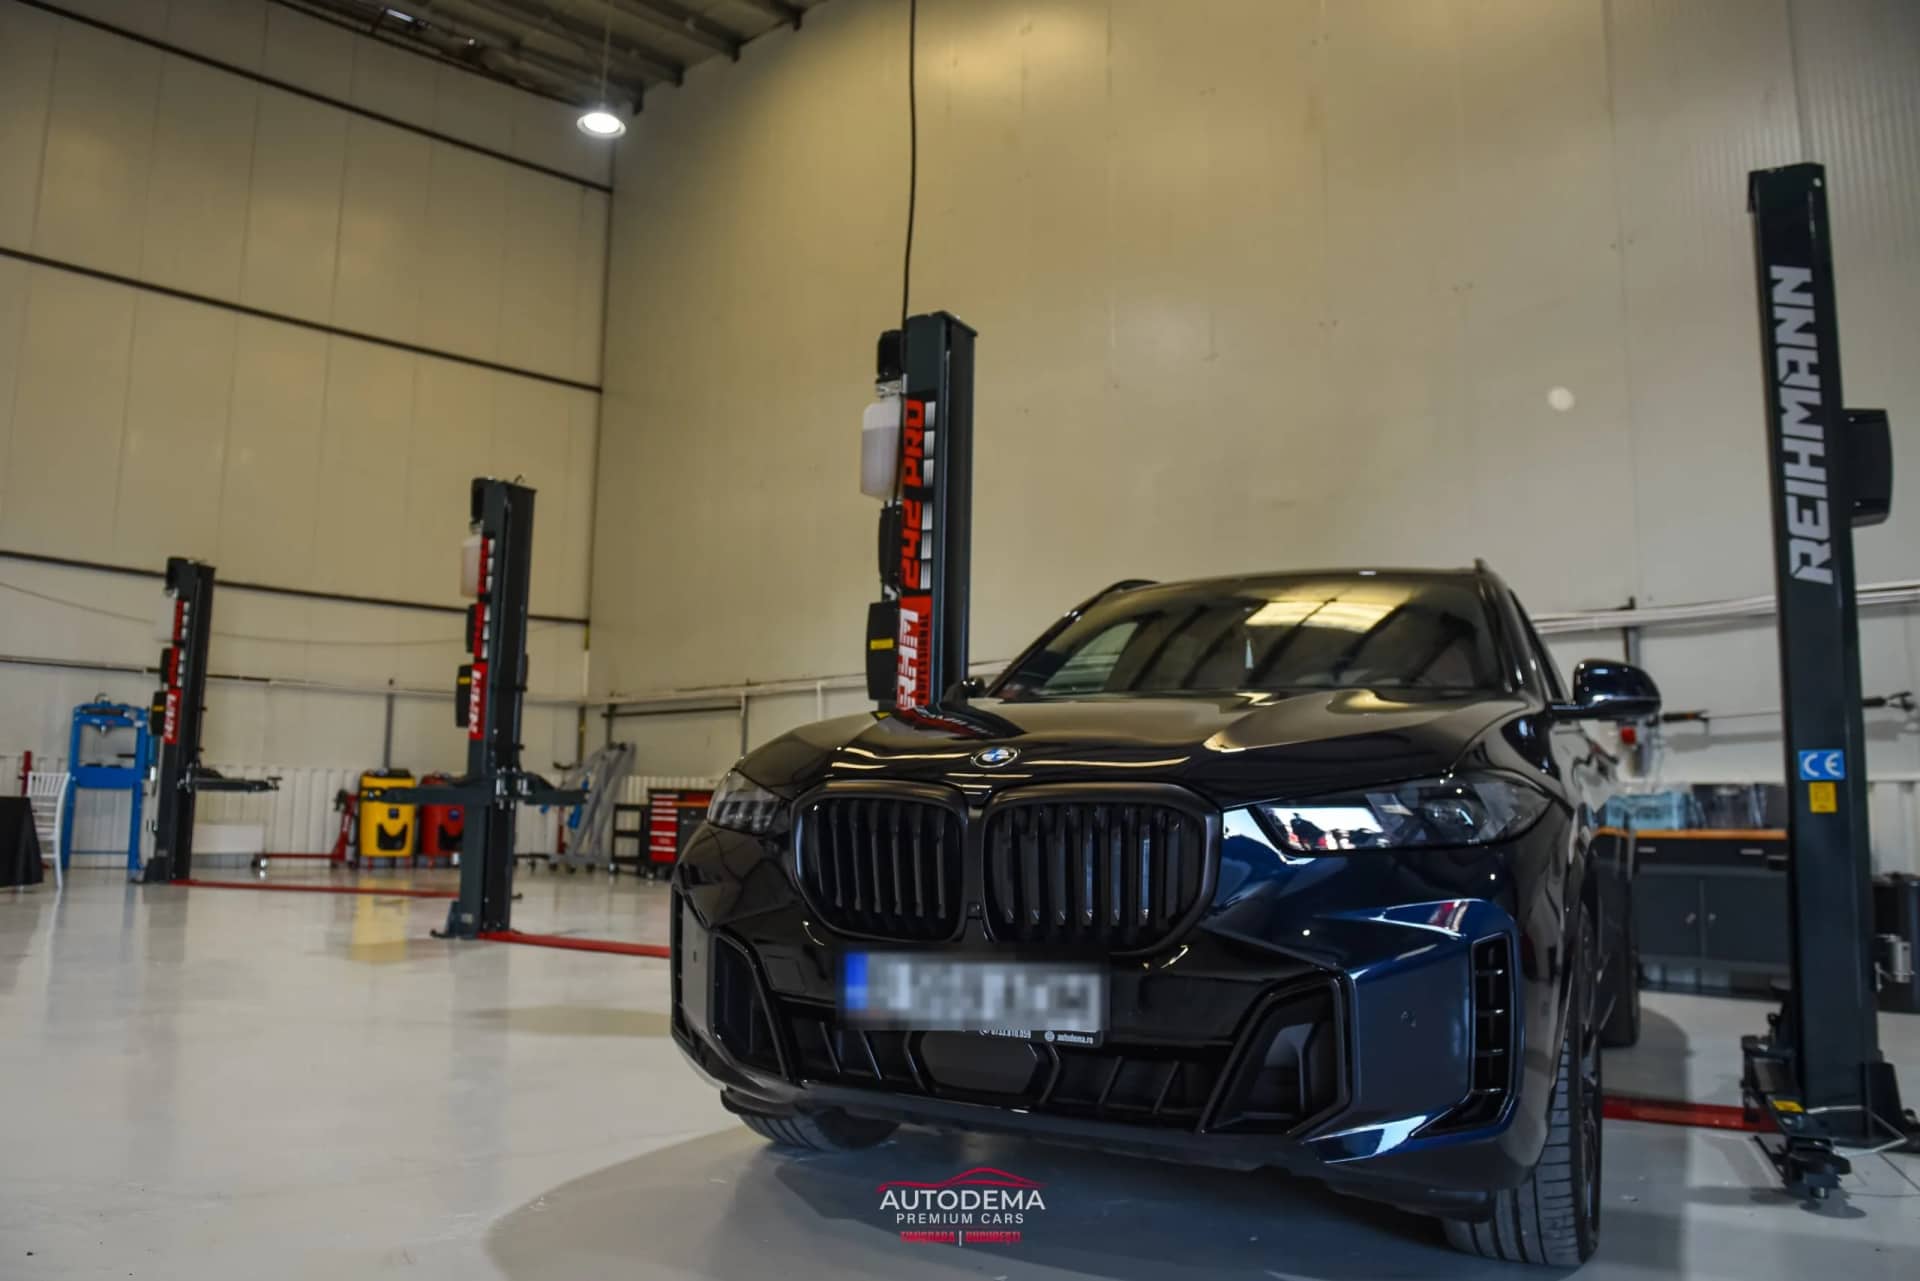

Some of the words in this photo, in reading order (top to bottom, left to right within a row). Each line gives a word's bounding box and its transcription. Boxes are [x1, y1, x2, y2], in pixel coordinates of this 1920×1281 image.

[902, 399, 924, 487] PRO
[1769, 265, 1833, 584] REIHMANN
[900, 499, 921, 590] 242
[1804, 753, 1841, 777] CE
